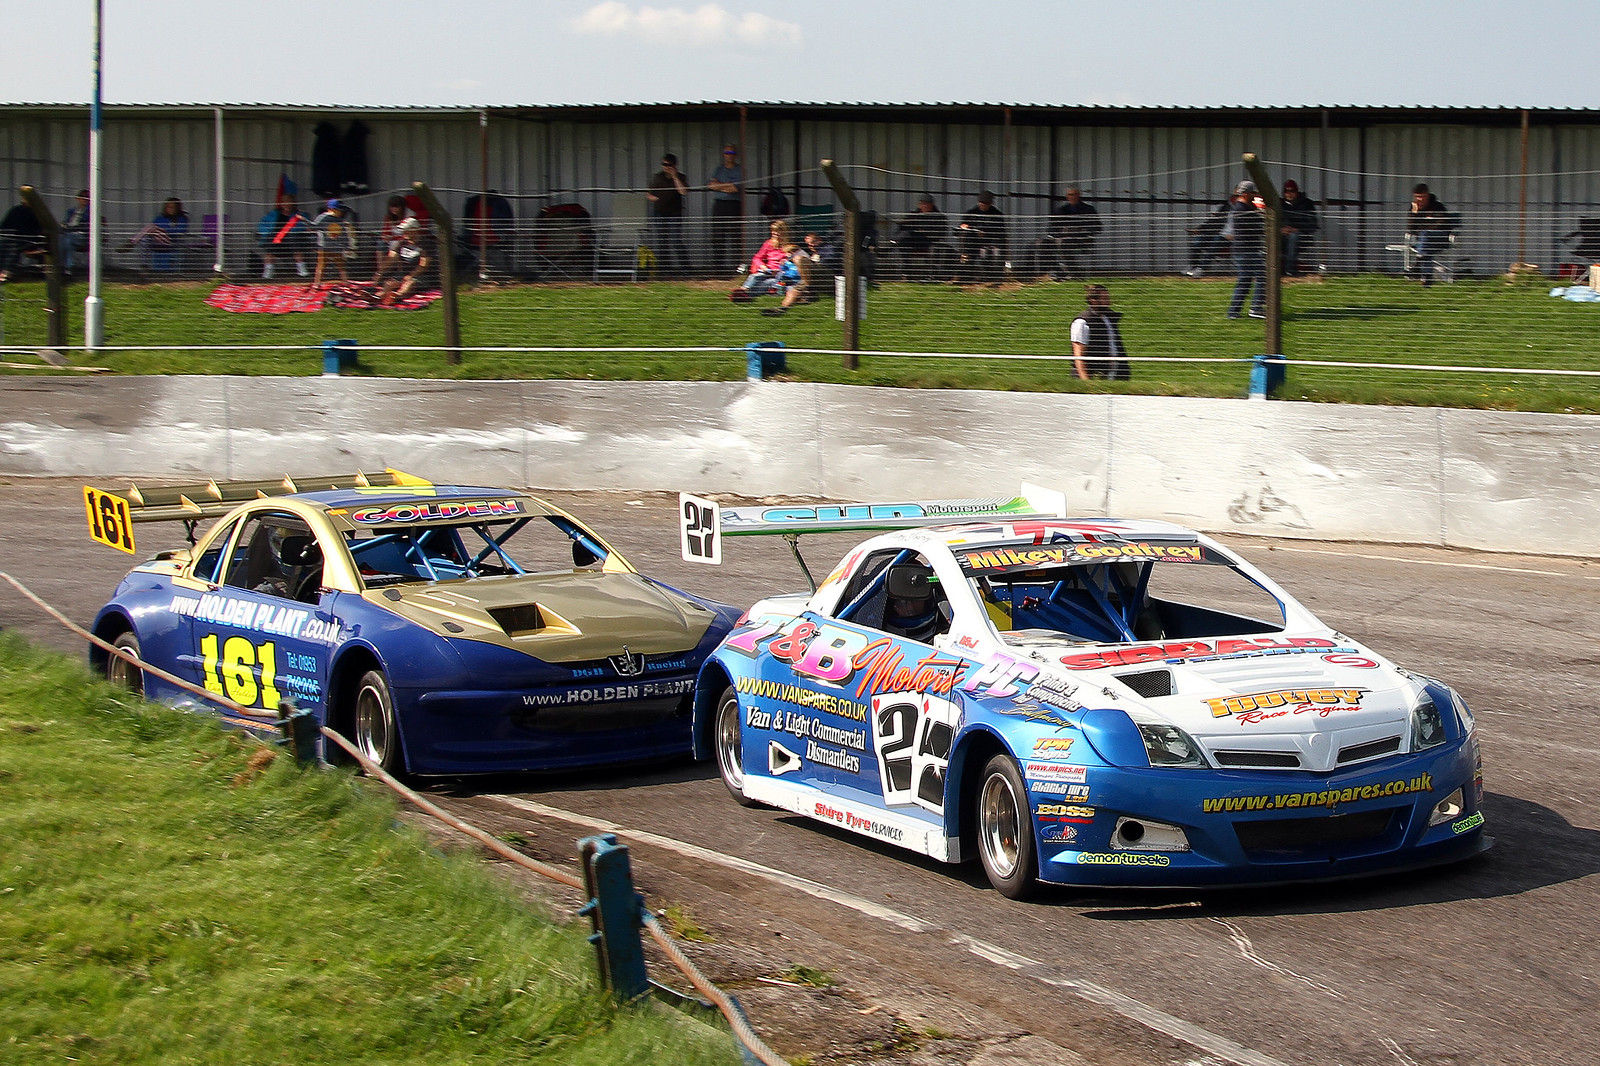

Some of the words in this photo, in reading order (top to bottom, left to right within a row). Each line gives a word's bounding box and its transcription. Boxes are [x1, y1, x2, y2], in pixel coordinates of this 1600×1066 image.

[87, 490, 132, 549] 161
[352, 500, 520, 523] GOLDEN
[927, 503, 998, 514] Motorsport
[965, 549, 1065, 569] Mikey
[1074, 542, 1202, 561] Godfrey
[200, 633, 281, 710] 161
[646, 659, 688, 671] Racing
[853, 637, 970, 697] Motors
[964, 652, 1041, 698] PC
[1038, 672, 1068, 694] Paints
[736, 675, 868, 723] WWW.VANSPARES.CO.UK
[1026, 683, 1083, 712] Components
[746, 705, 771, 729] Van
[773, 711, 784, 729] &
[785, 713, 811, 736] Light
[811, 718, 867, 751] Commercial
[1236, 710, 1290, 726] Race
[1293, 702, 1362, 717] Engines
[805, 739, 861, 773] Dismantlers
[1030, 749, 1071, 760] Signs
[1032, 738, 1074, 750] TPR
[1027, 763, 1086, 775] www.mkpics.net
[1203, 771, 1433, 813] www.vanspares.co.uk
[815, 802, 844, 823] Shire
[845, 811, 872, 832] Tyre
[871, 821, 904, 842] SERVICES
[1036, 804, 1096, 818] BOSS
